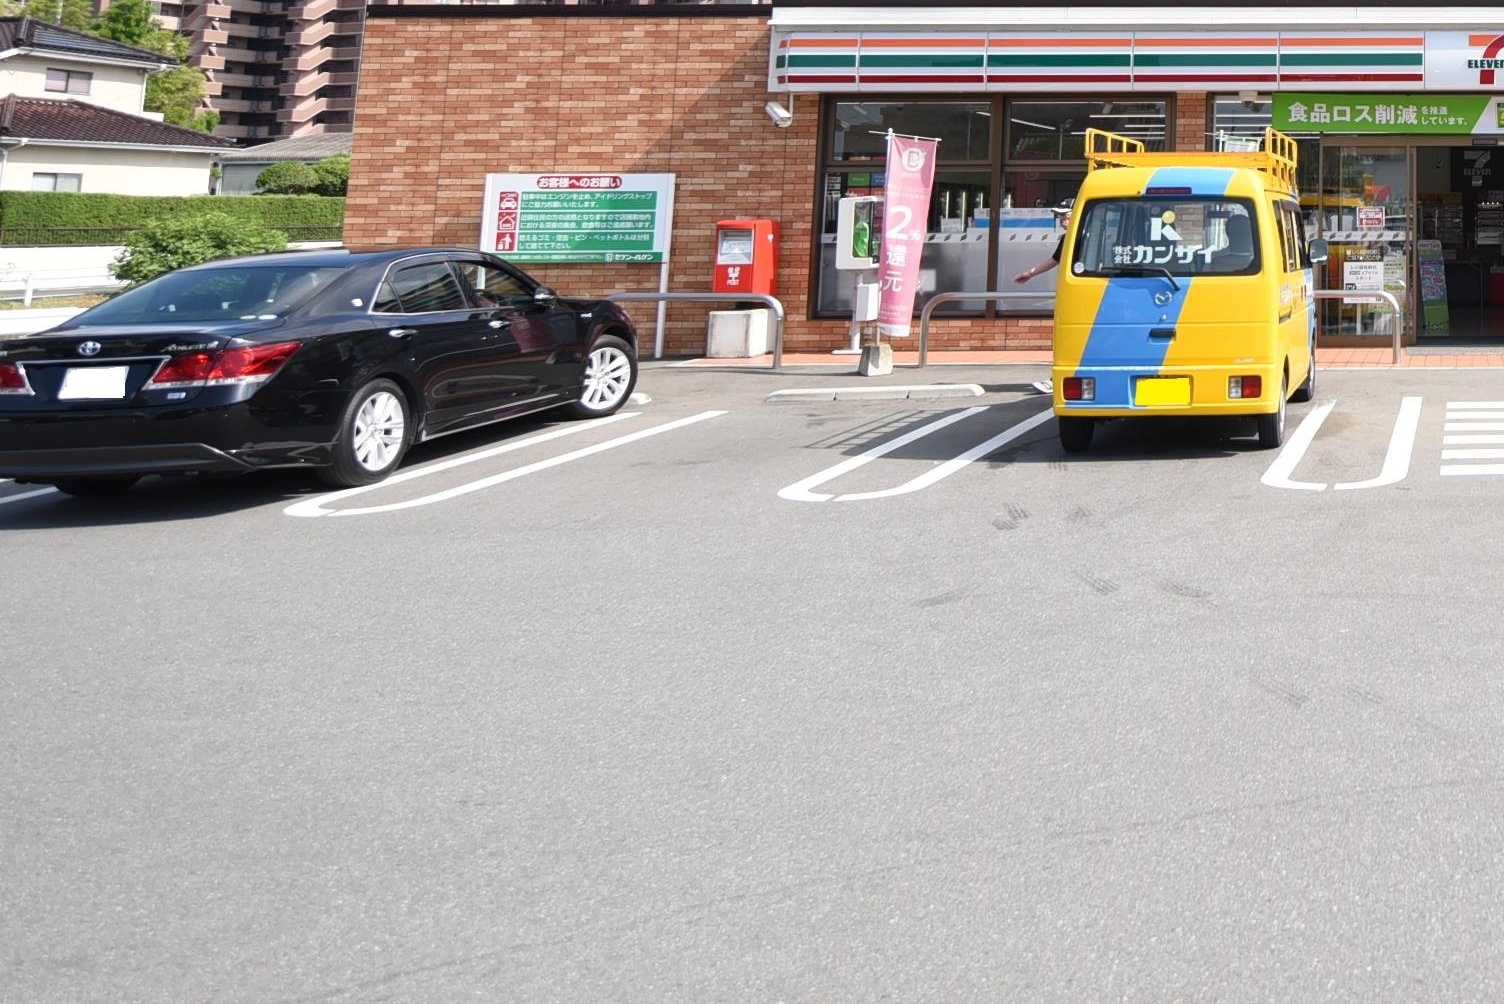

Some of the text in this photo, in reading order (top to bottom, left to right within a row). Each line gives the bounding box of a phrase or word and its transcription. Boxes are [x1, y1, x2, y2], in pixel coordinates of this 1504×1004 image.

[1288, 102, 1418, 125] 食品ロス削減
[538, 176, 621, 188] お客様へのお願い
